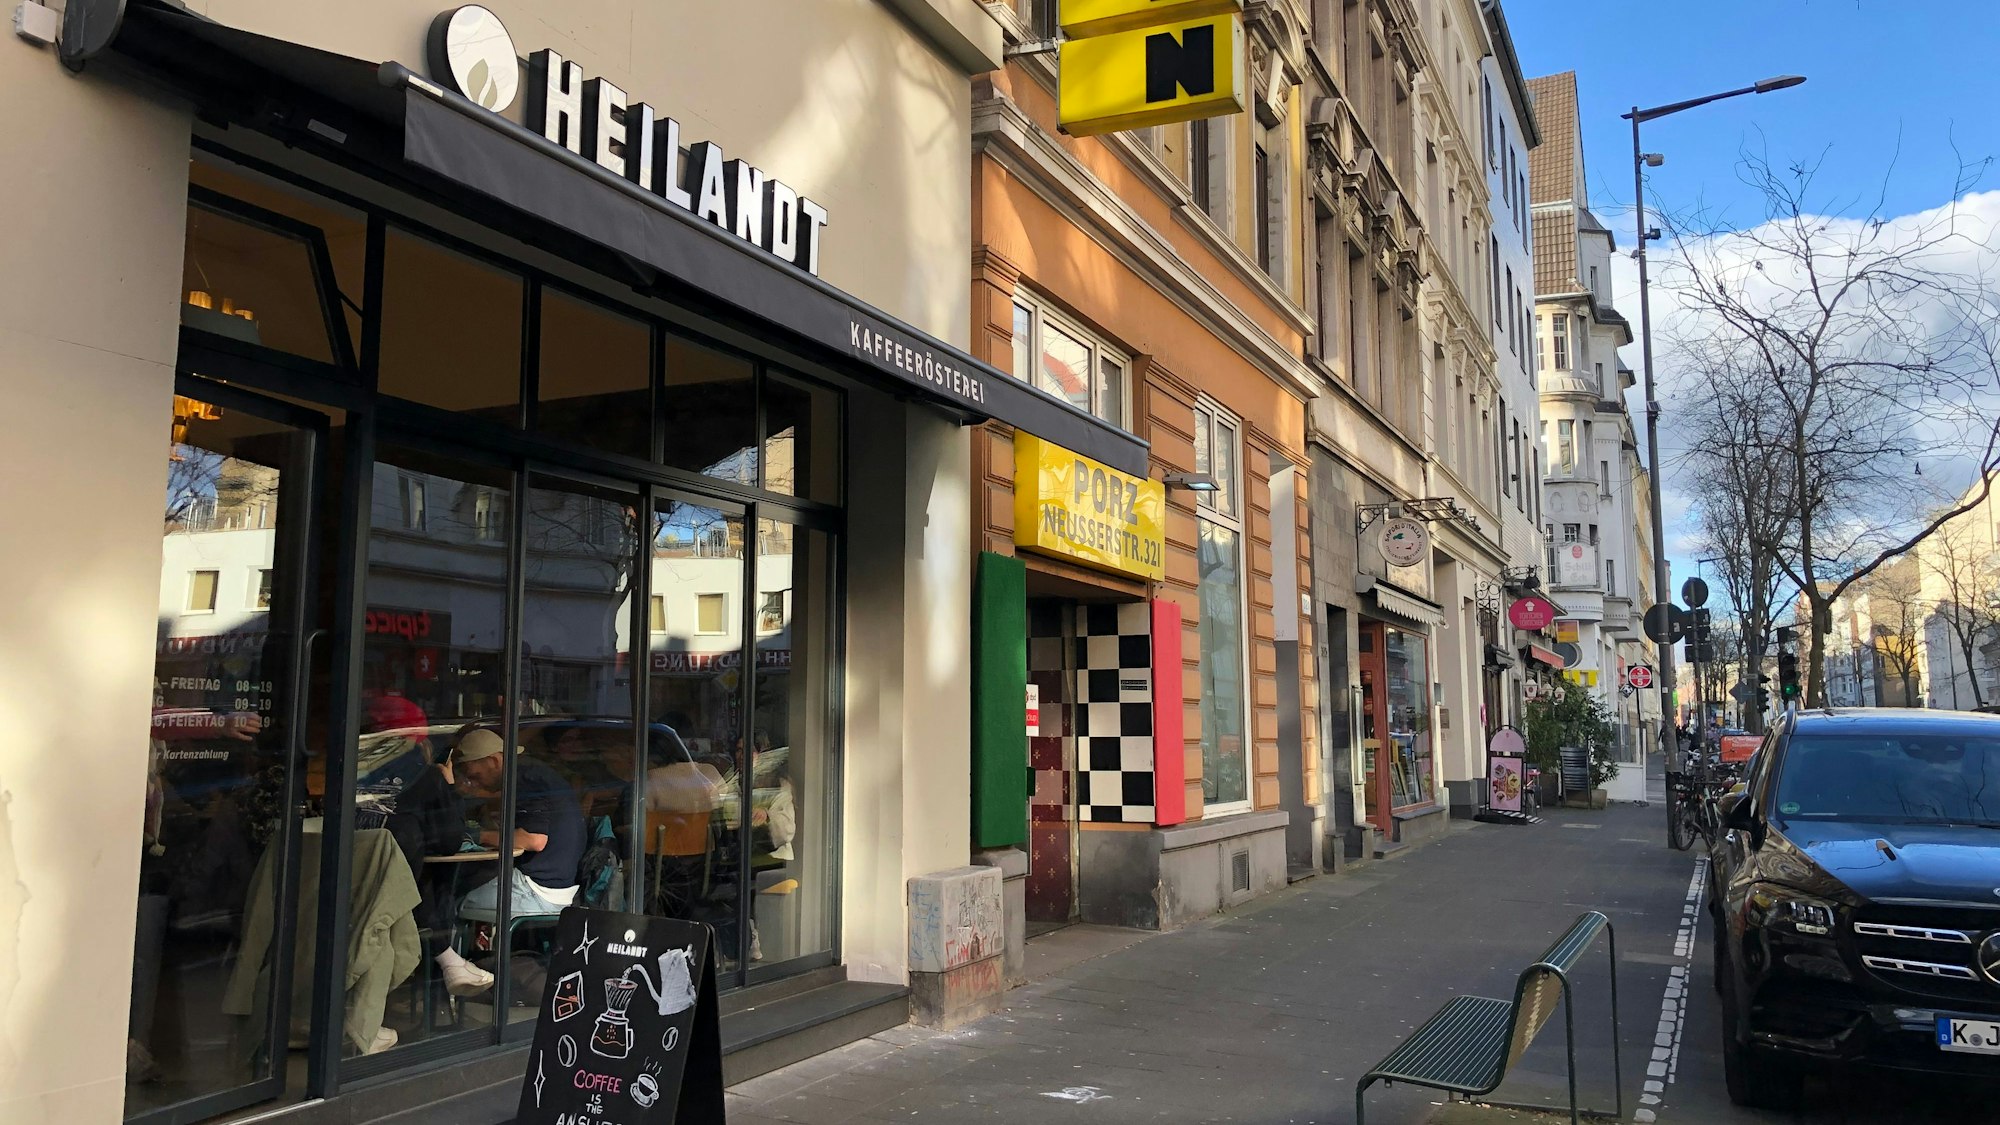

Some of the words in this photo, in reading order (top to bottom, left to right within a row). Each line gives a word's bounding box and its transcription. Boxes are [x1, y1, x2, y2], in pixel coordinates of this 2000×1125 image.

[1146, 24, 1214, 104] N
[529, 47, 828, 278] HEILANDT
[850, 320, 985, 404] KAFFEERÖSTEREI
[1074, 458, 1138, 526] PORZ
[170, 677, 221, 691] FREITAG
[168, 715, 226, 728] FEIERTAG
[163, 749, 230, 761] Kartenzahlung
[606, 943, 648, 958] HEILANDT
[1953, 1022, 1968, 1044] K
[573, 1069, 623, 1093] COFFEE
[586, 1103, 604, 1114] THE
[591, 1094, 602, 1105] IS
